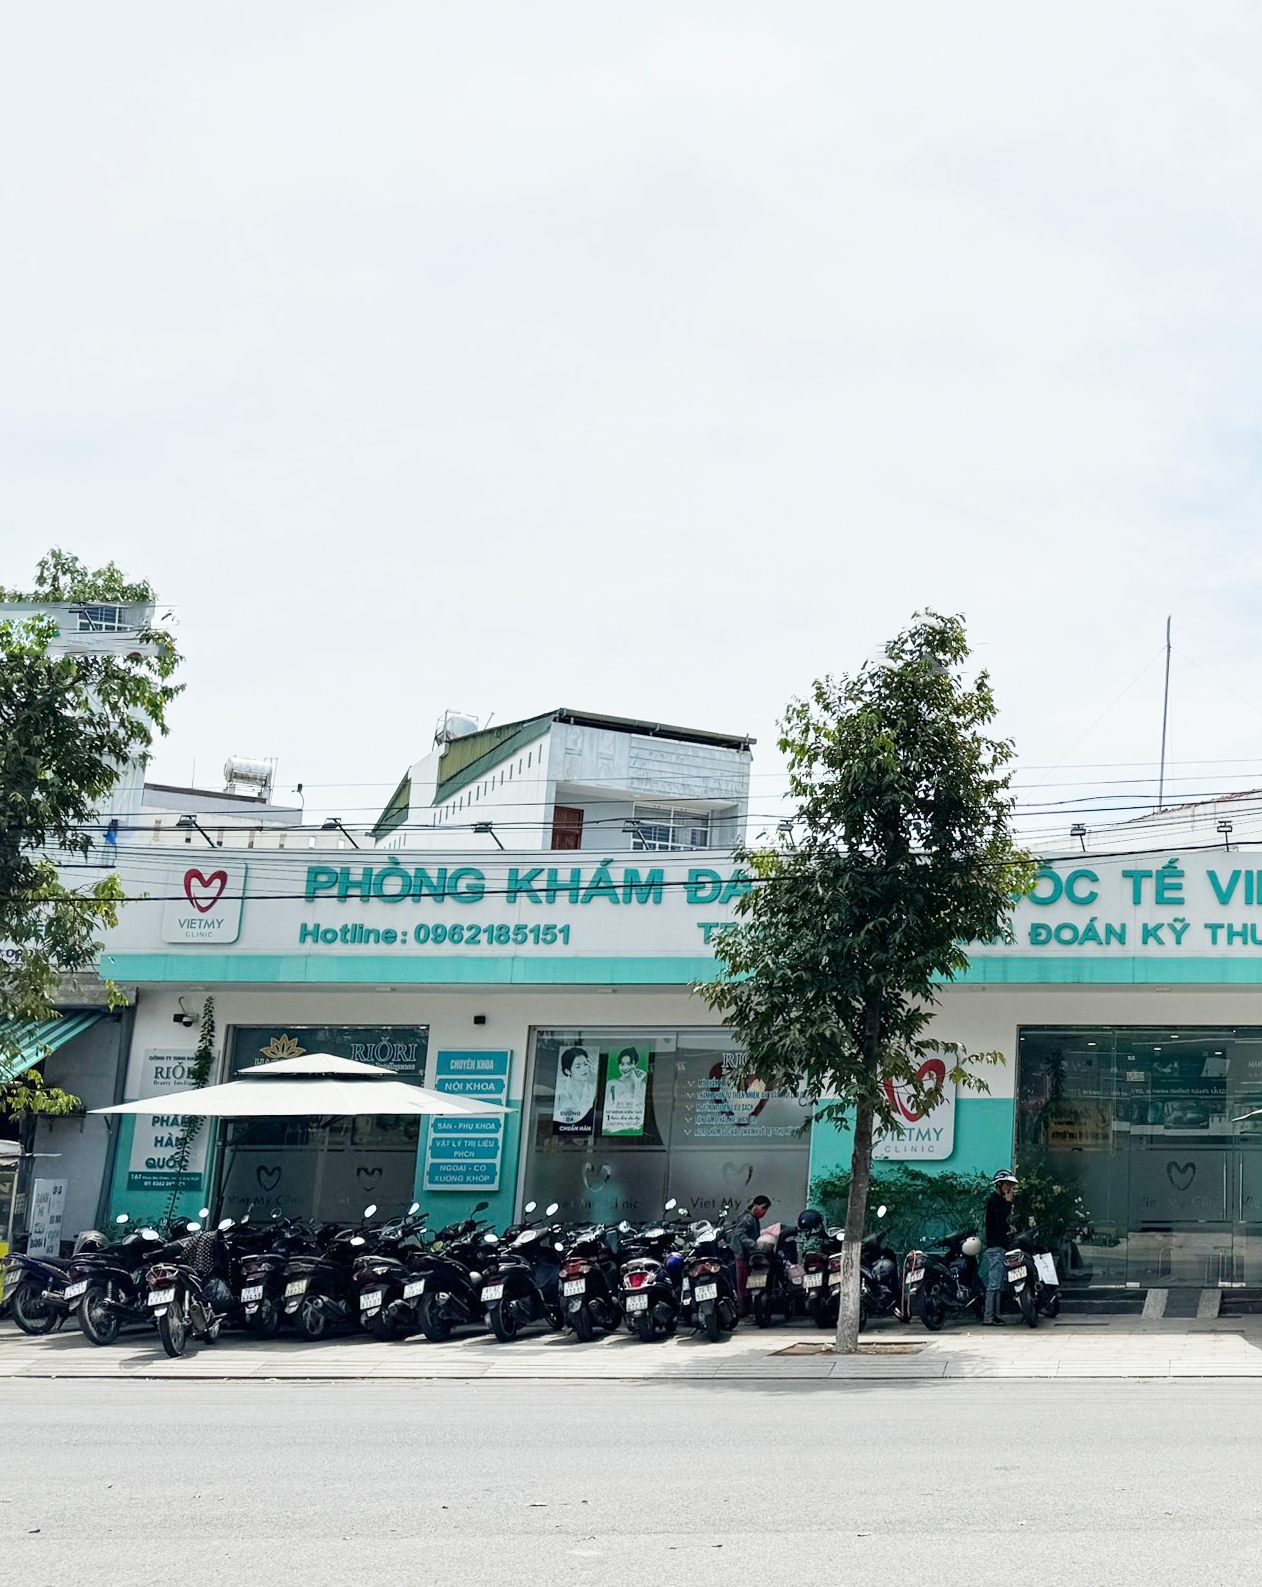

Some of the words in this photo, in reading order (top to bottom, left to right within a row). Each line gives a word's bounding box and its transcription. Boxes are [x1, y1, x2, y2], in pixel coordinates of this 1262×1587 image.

[305, 856, 486, 904] PHÒNG
[505, 858, 665, 904] KHÁM
[683, 867, 753, 904] ĐA
[1014, 860, 1099, 906] ỐC
[1122, 857, 1185, 905] TẾ
[178, 918, 224, 930] VIETMY
[299, 922, 407, 944] Hotline:
[414, 923, 571, 945] 0962185151
[1028, 917, 1126, 946] ĐOÁN
[1142, 917, 1190, 946] KỸ
[450, 1058, 475, 1071] CHUYÊN
[476, 1059, 494, 1070] KHOA
[445, 1081, 463, 1092] NỘI
[466, 1082, 496, 1091] KHOA
[884, 1145, 935, 1153] CLINIC
